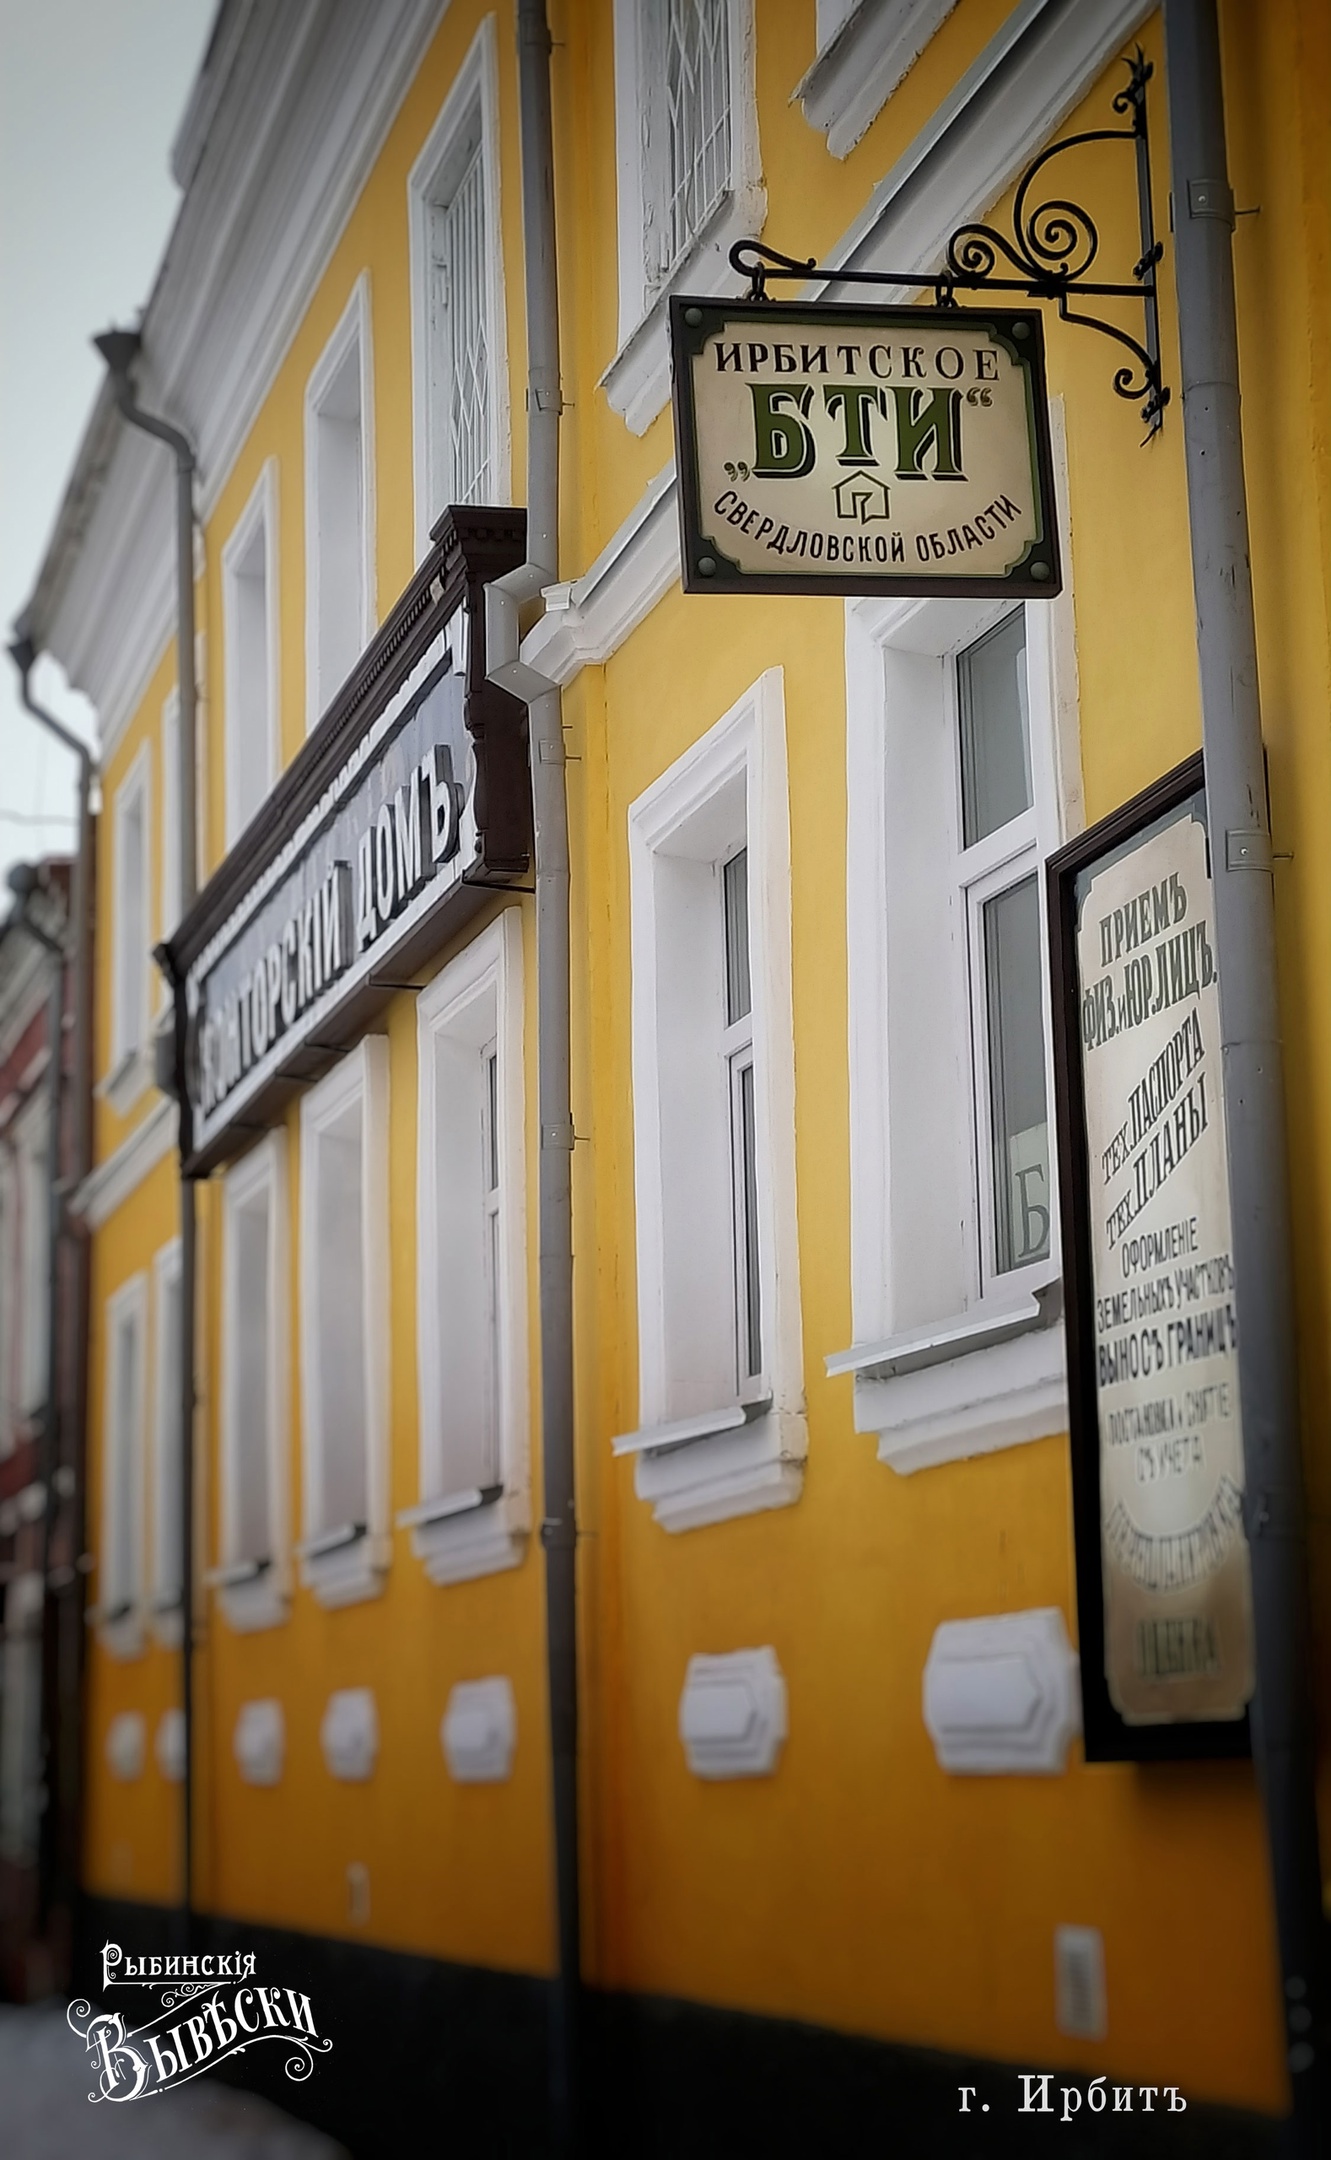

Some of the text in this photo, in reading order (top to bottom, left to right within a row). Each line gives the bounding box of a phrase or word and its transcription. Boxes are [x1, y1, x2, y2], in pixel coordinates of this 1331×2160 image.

[713, 341, 1000, 381] ИРБИТСКОЕ
[713, 489, 1023, 563] СВЕРДЛОВСКОЙ ОБЛАСТИ
[357, 745, 460, 953] ДОМЪ
[1099, 871, 1188, 968] ПРИЕМЪ
[1128, 1007, 1205, 1150] ПАСПОРТА
[1133, 1071, 1208, 1214] ПЛАНЫ
[1121, 1216, 1198, 1278] ОФОРМЛЕНІЕ
[1097, 1275, 1174, 1333] ЗЕМЕЛЬНЫХЪ
[1099, 1327, 1164, 1387] ВЫНОСЪ
